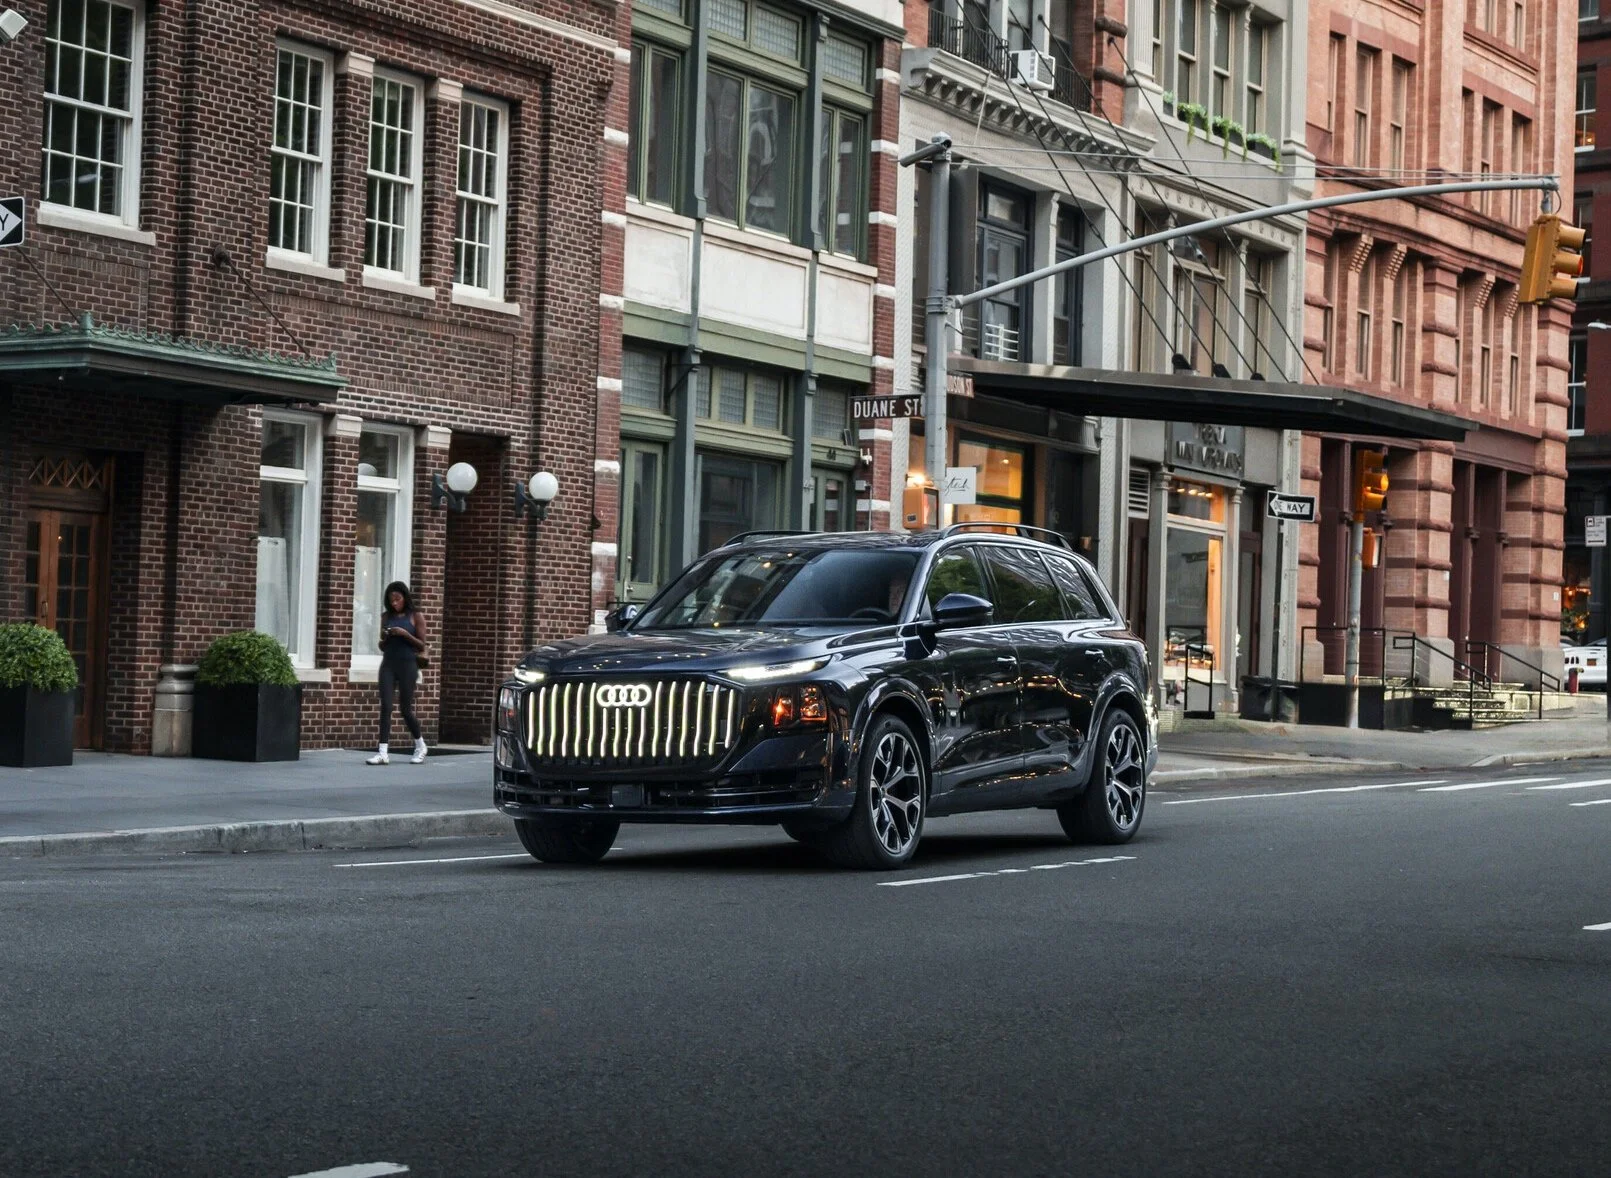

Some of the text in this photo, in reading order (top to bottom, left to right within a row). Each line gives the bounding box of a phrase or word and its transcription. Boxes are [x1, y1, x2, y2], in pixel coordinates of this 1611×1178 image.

[853, 398, 919, 418] DUANE ST
[1287, 503, 1305, 513] WAY
